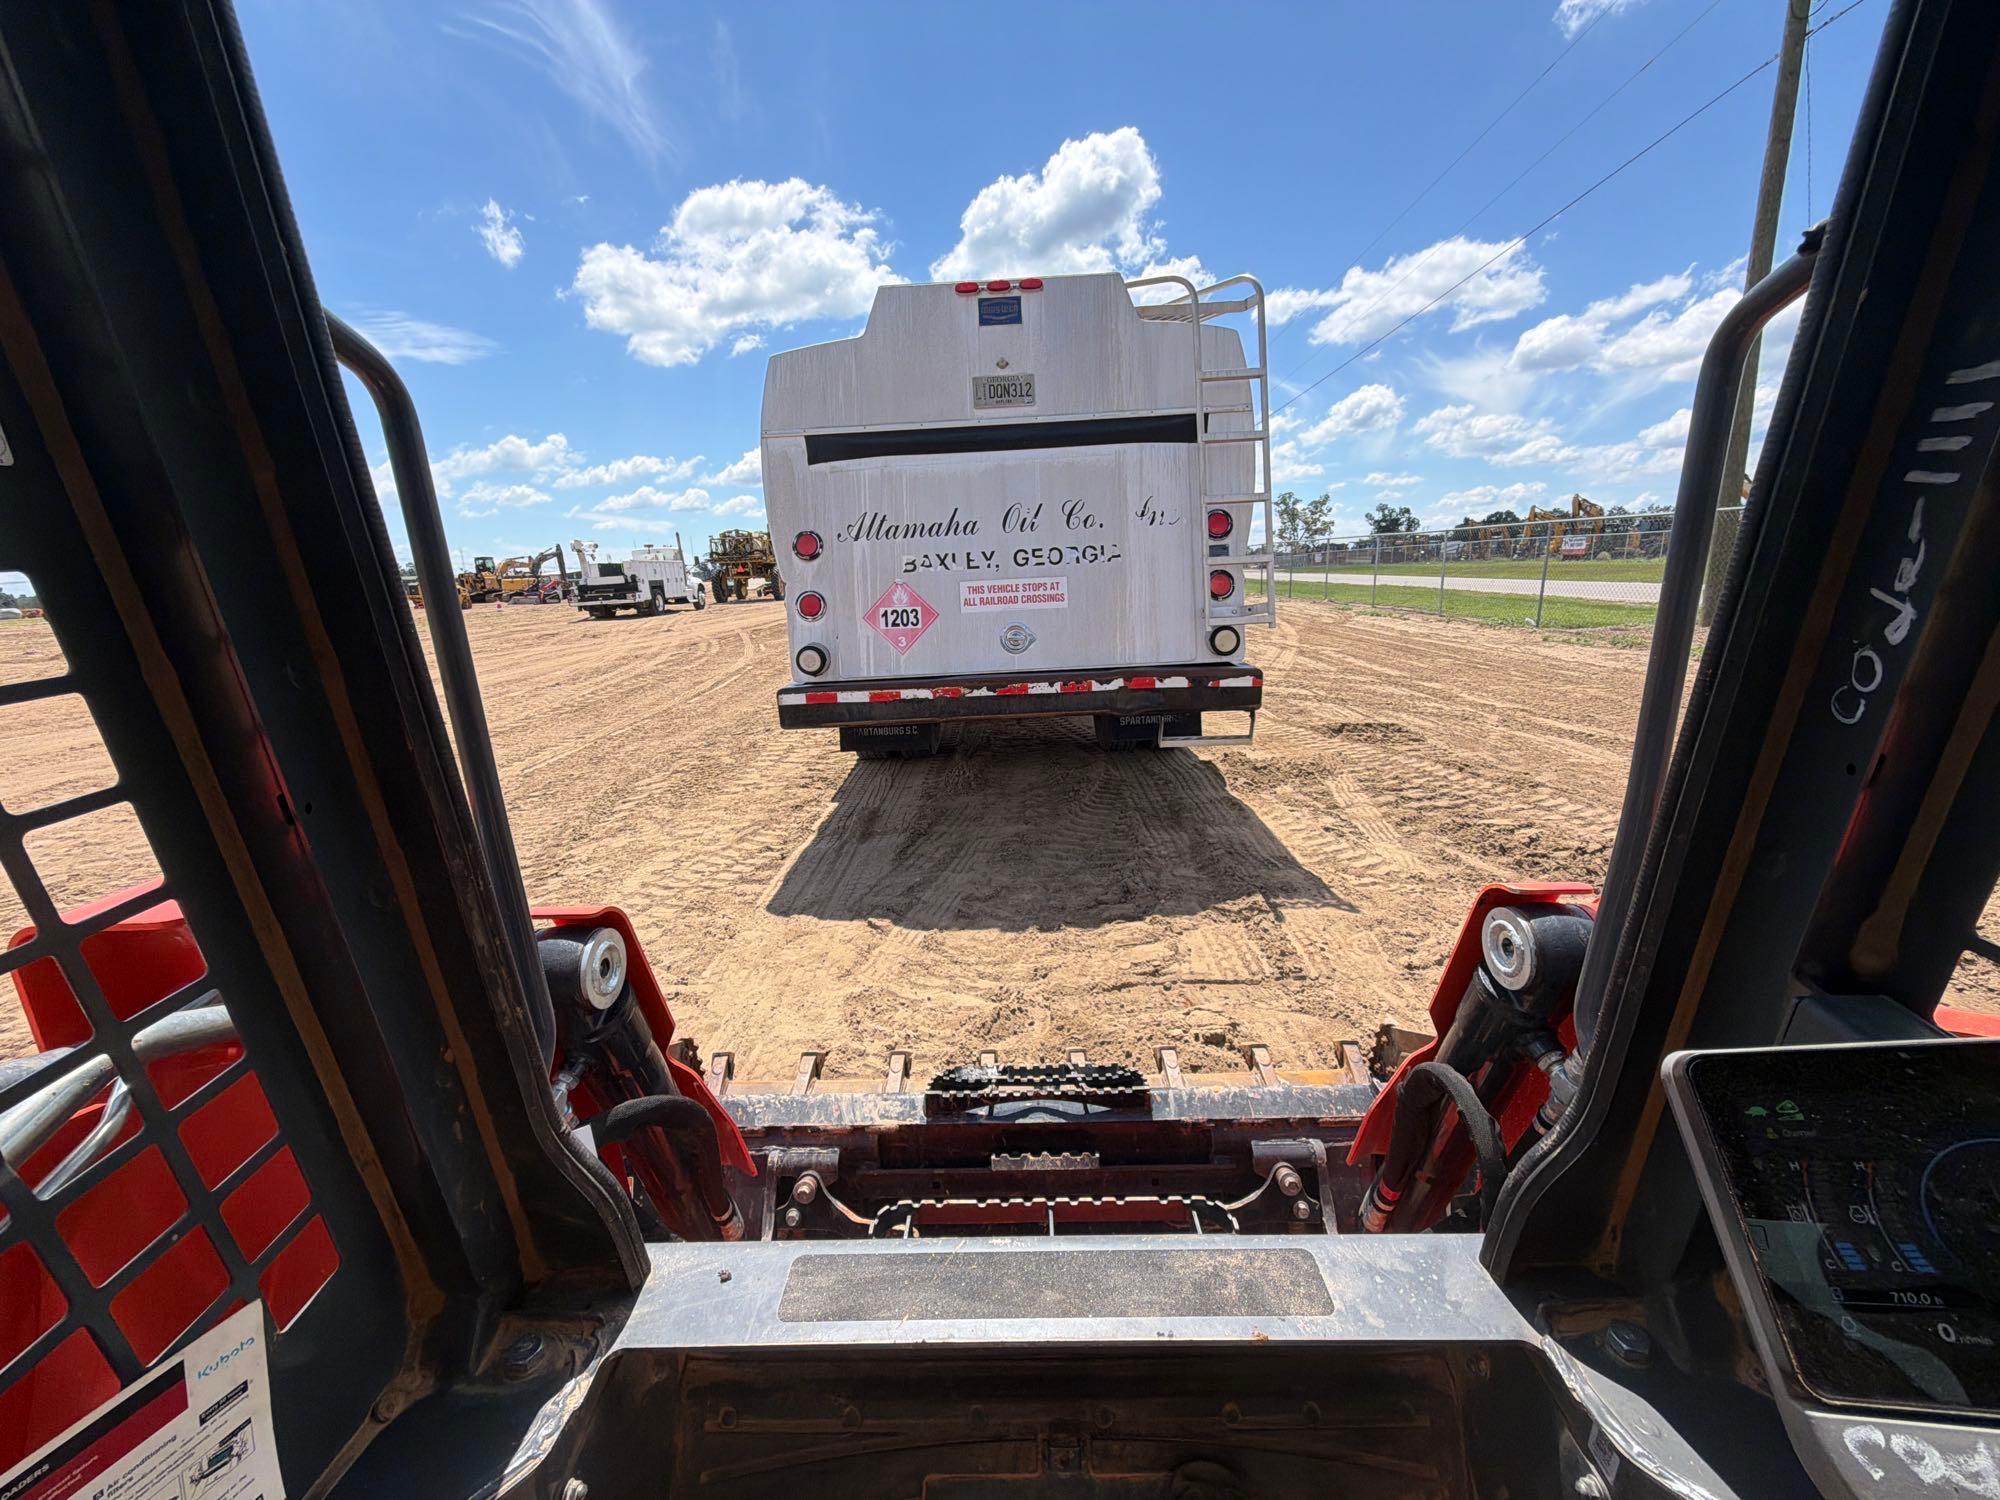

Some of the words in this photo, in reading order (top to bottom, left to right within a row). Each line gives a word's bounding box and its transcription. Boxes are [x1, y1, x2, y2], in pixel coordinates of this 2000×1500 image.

[989, 382, 1032, 399] DQN312
[837, 508, 980, 543] Altamaha
[1001, 502, 1043, 534] Oil
[1062, 499, 1104, 530] Co.
[966, 585, 985, 595] THIS
[987, 583, 1020, 594] VEHICLE
[1022, 582, 1048, 592] STOPS
[1050, 581, 1060, 591] AT
[963, 598, 977, 607] ALL
[979, 595, 1019, 606] RAILROAD
[1021, 593, 1065, 604] CROSSINGS
[880, 608, 921, 628] 1203
[898, 636, 907, 647] 3
[1119, 713, 1177, 726] SPARTANBRG
[849, 725, 904, 736] PARTANBURG
[1889, 1292, 1931, 1305] 710.0
[1937, 1323, 1956, 1343] 0
[197, 1337, 255, 1379] Kubota
